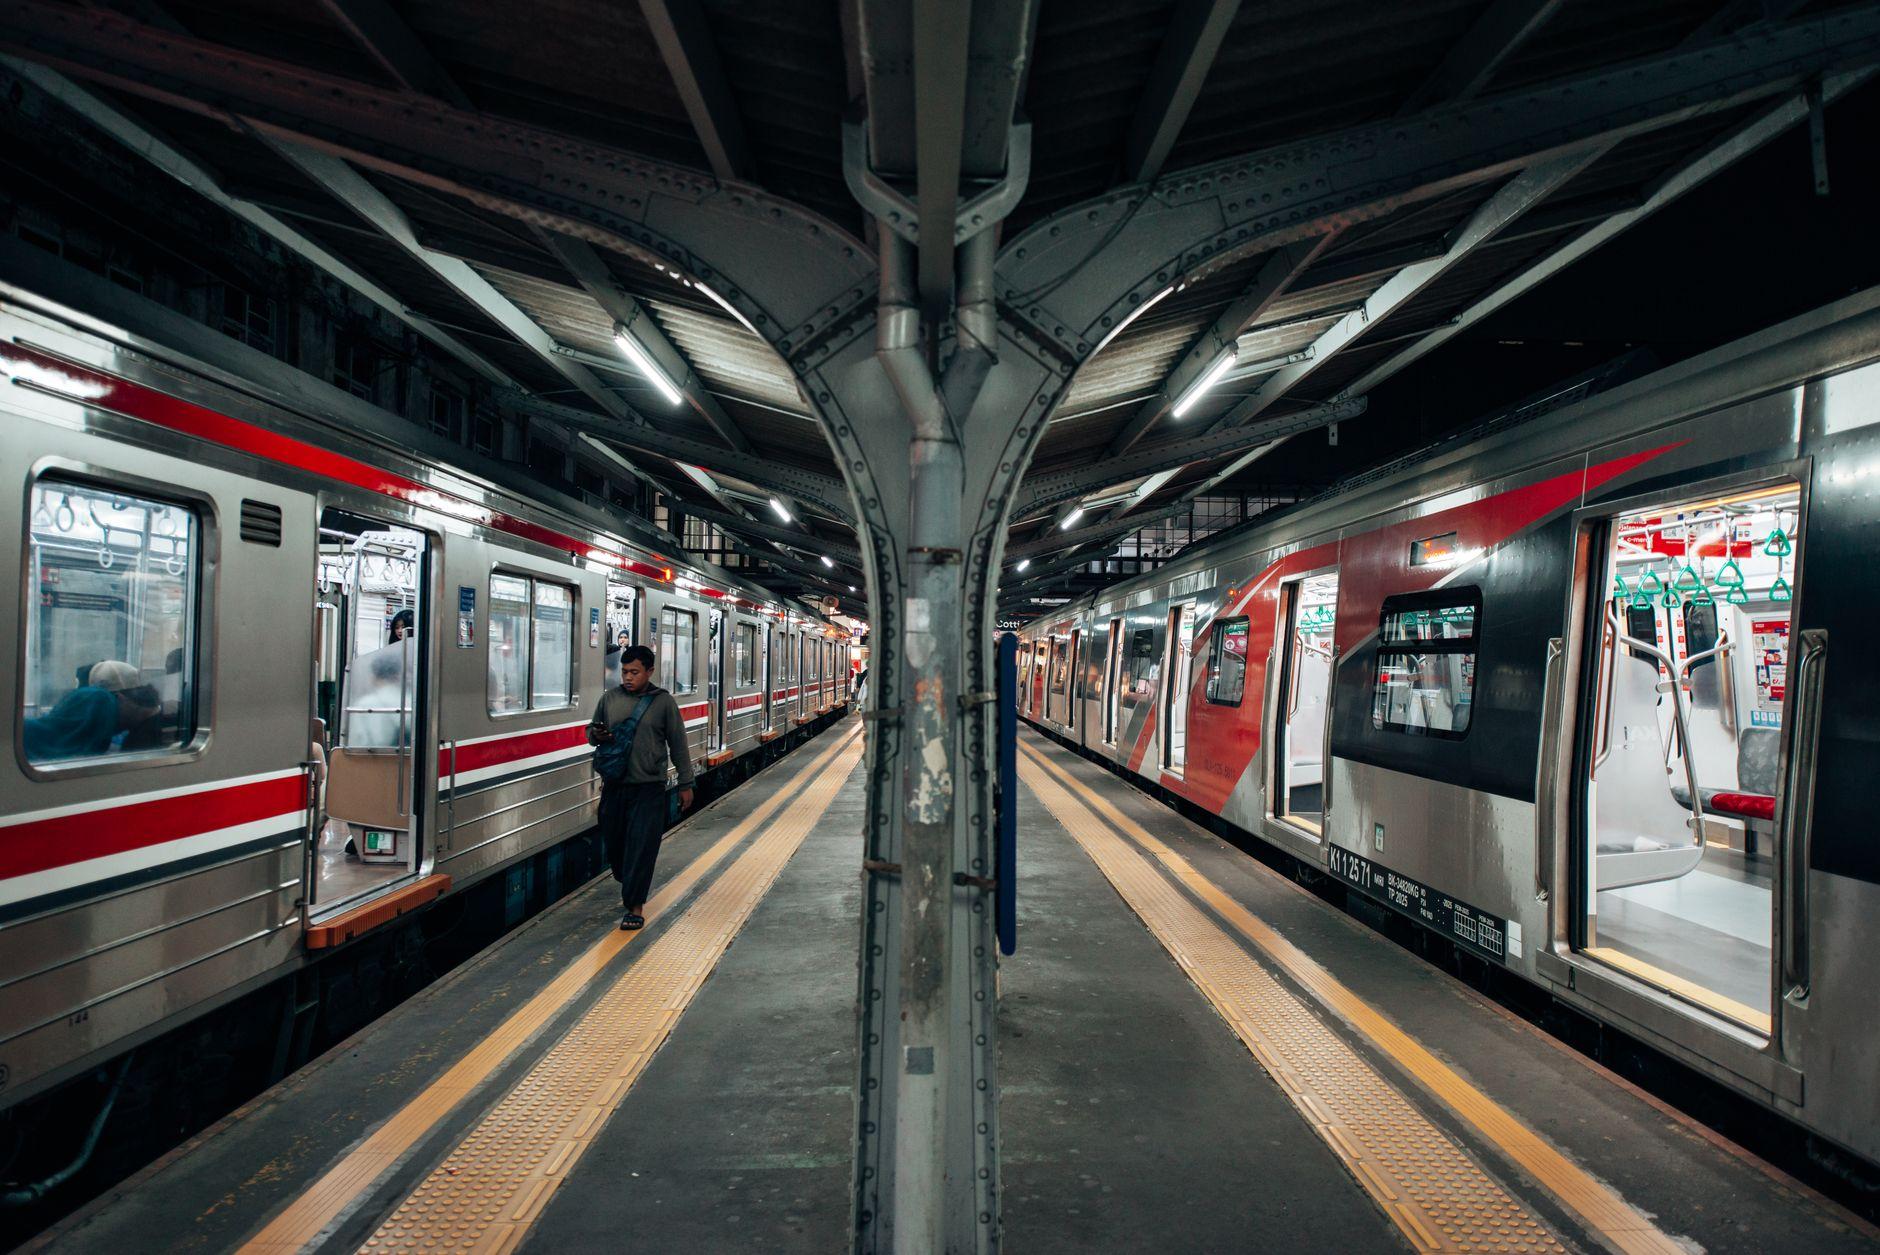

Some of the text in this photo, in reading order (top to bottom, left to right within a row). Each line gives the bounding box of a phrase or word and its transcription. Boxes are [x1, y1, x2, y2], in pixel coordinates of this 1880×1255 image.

[996, 620, 1020, 628] Cotti
[1349, 856, 1359, 882] 25
[1361, 861, 1371, 888] 71
[1388, 887, 1395, 900] TP
